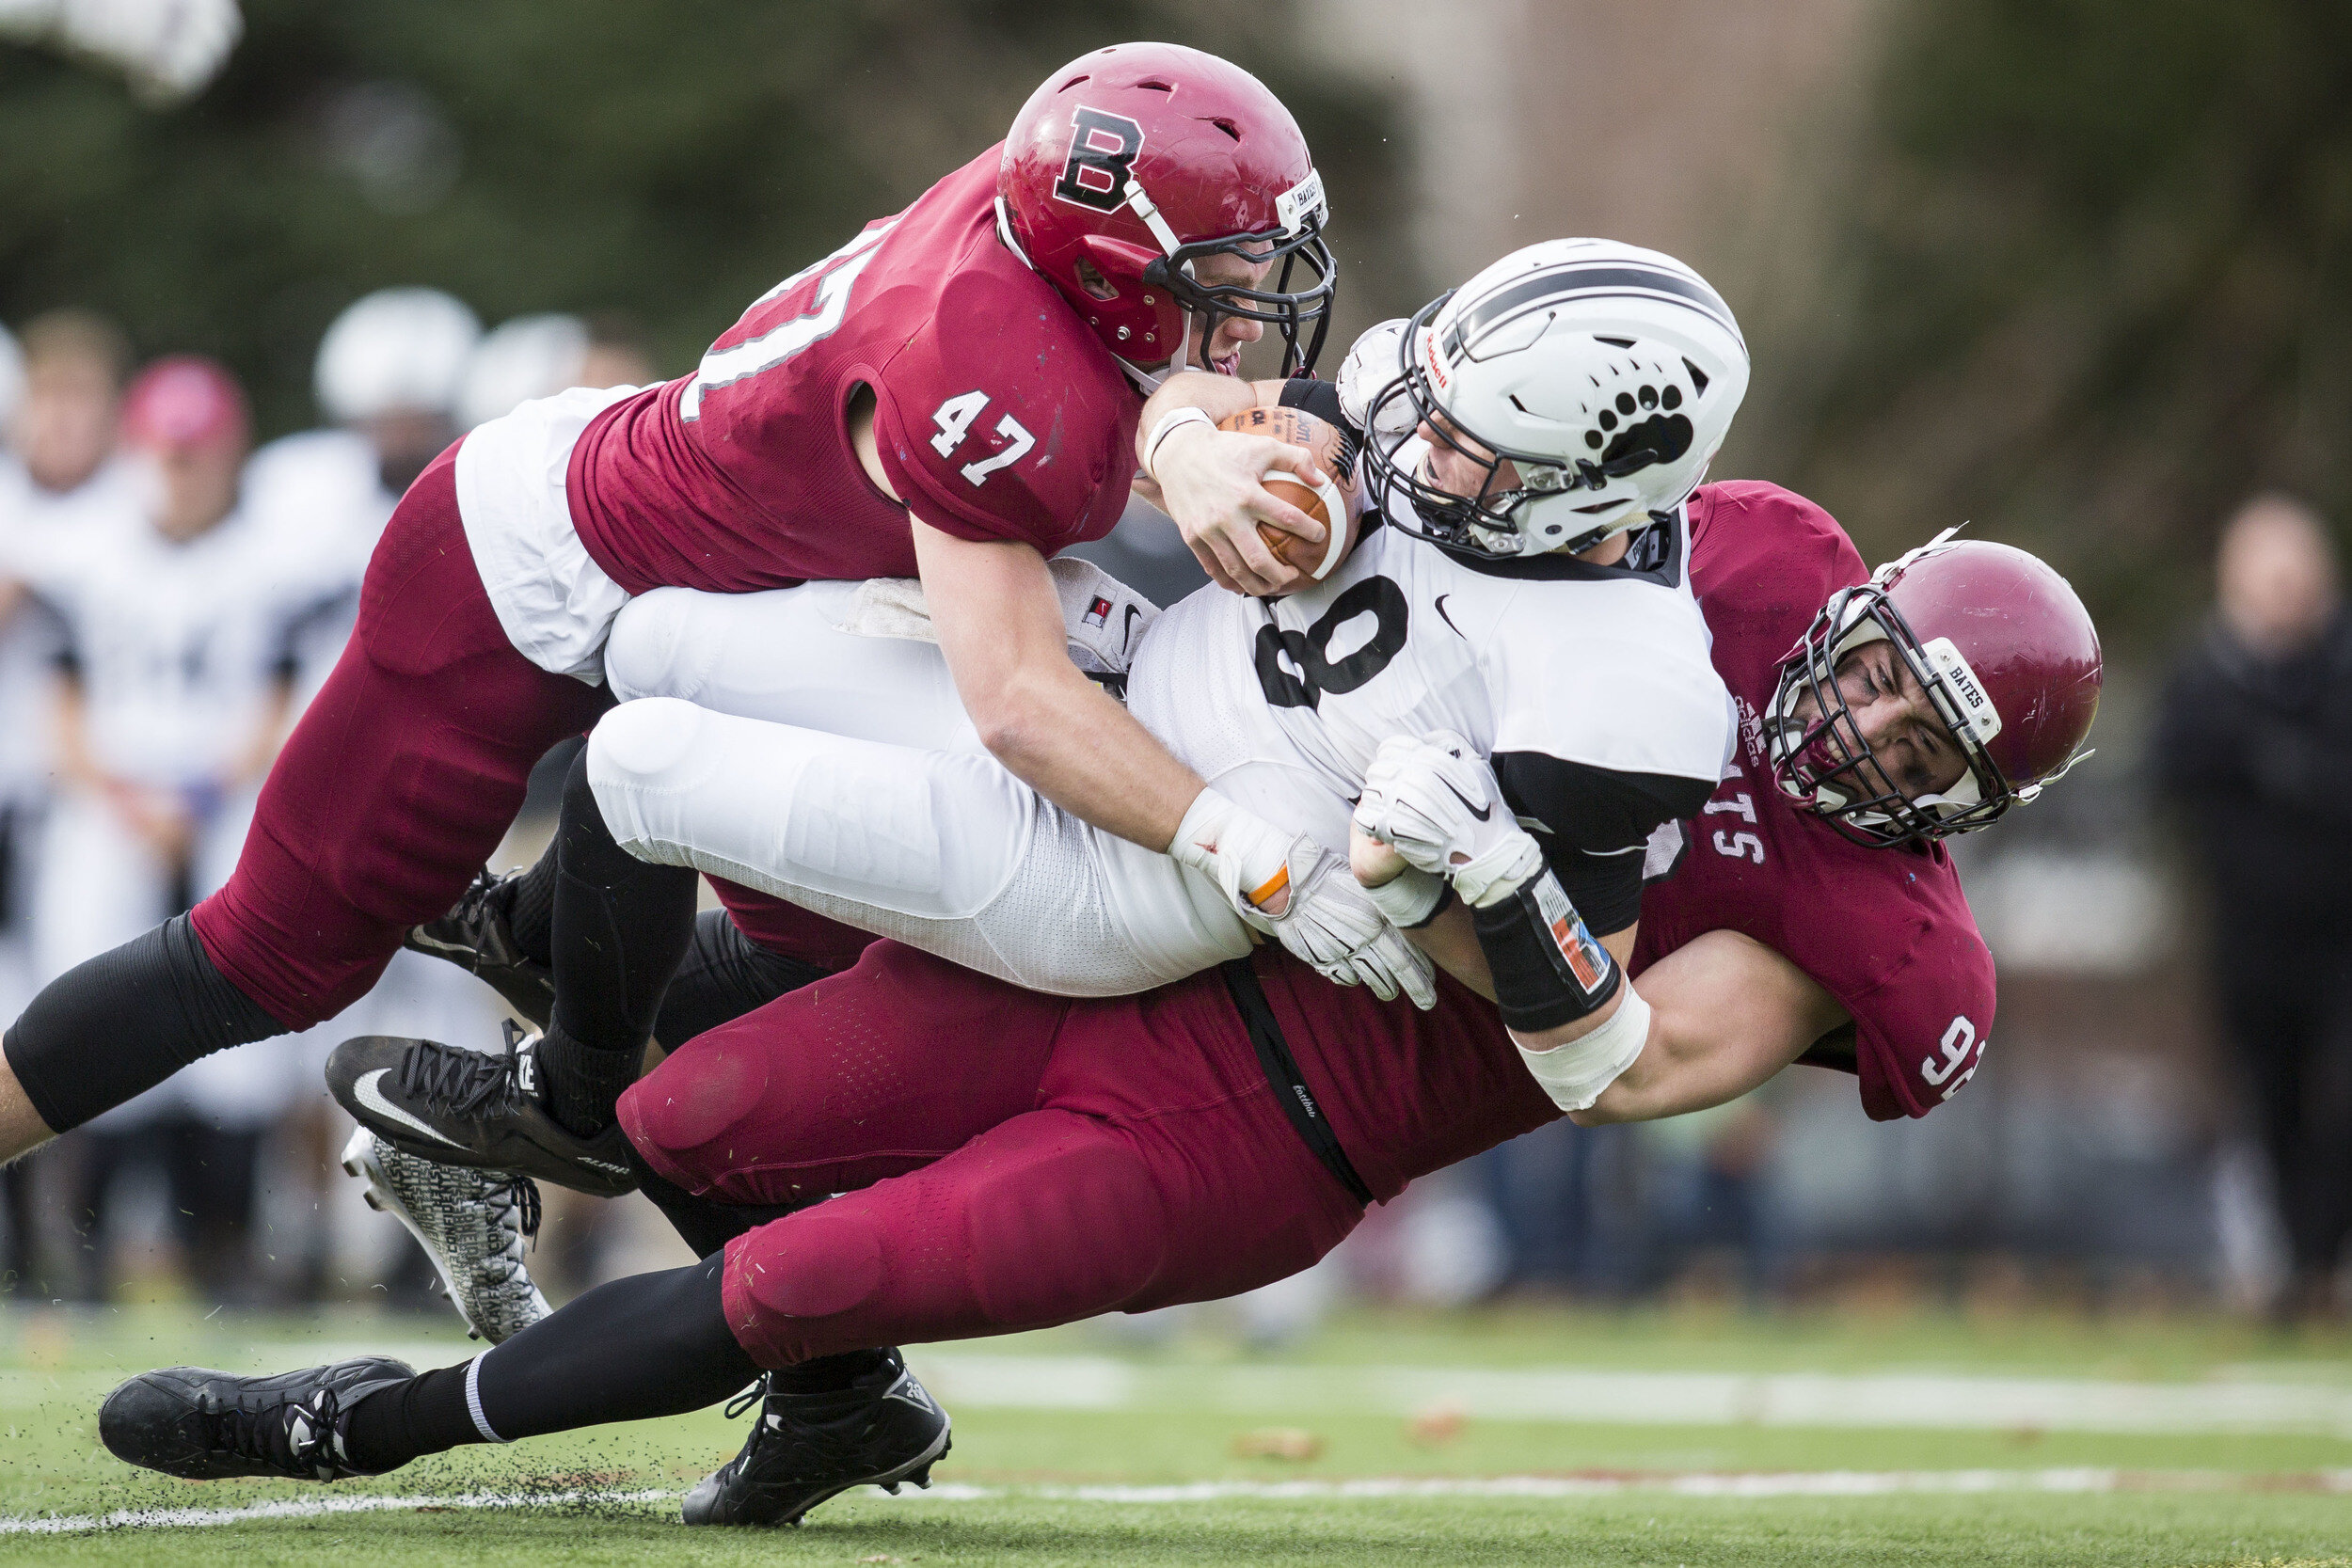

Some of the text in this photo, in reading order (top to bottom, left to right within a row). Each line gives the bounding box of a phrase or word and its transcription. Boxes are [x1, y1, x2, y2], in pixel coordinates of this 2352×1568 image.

[1053, 104, 1145, 214] B
[1297, 182, 1317, 206] BATES
[1426, 333, 1447, 388] Riddell
[930, 389, 1036, 487] 47
[1255, 575, 1408, 718] 8
[1948, 666, 1984, 708] BATES
[1734, 695, 1758, 767] adidas
